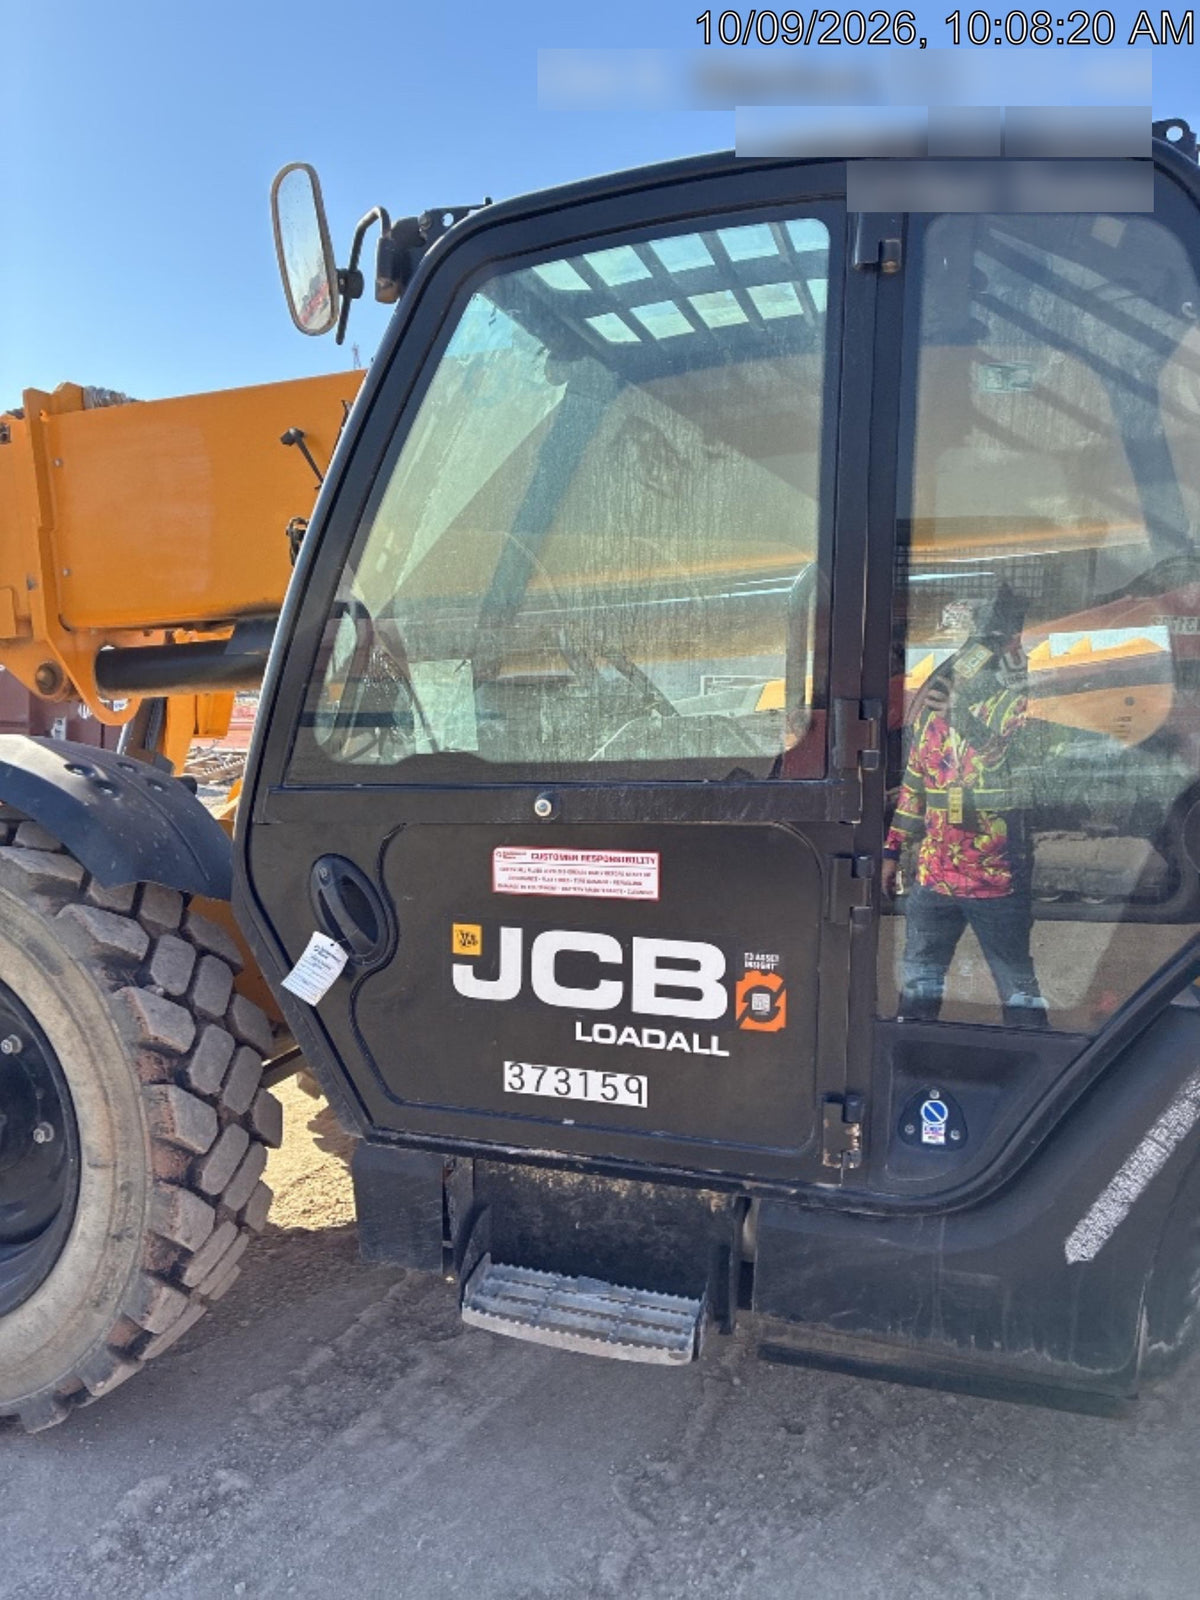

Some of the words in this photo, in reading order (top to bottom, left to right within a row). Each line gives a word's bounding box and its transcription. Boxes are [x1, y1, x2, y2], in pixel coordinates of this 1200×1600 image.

[452, 926, 729, 1021] JCB
[574, 1021, 730, 1057] LOADALL
[508, 1063, 645, 1105] 373159
